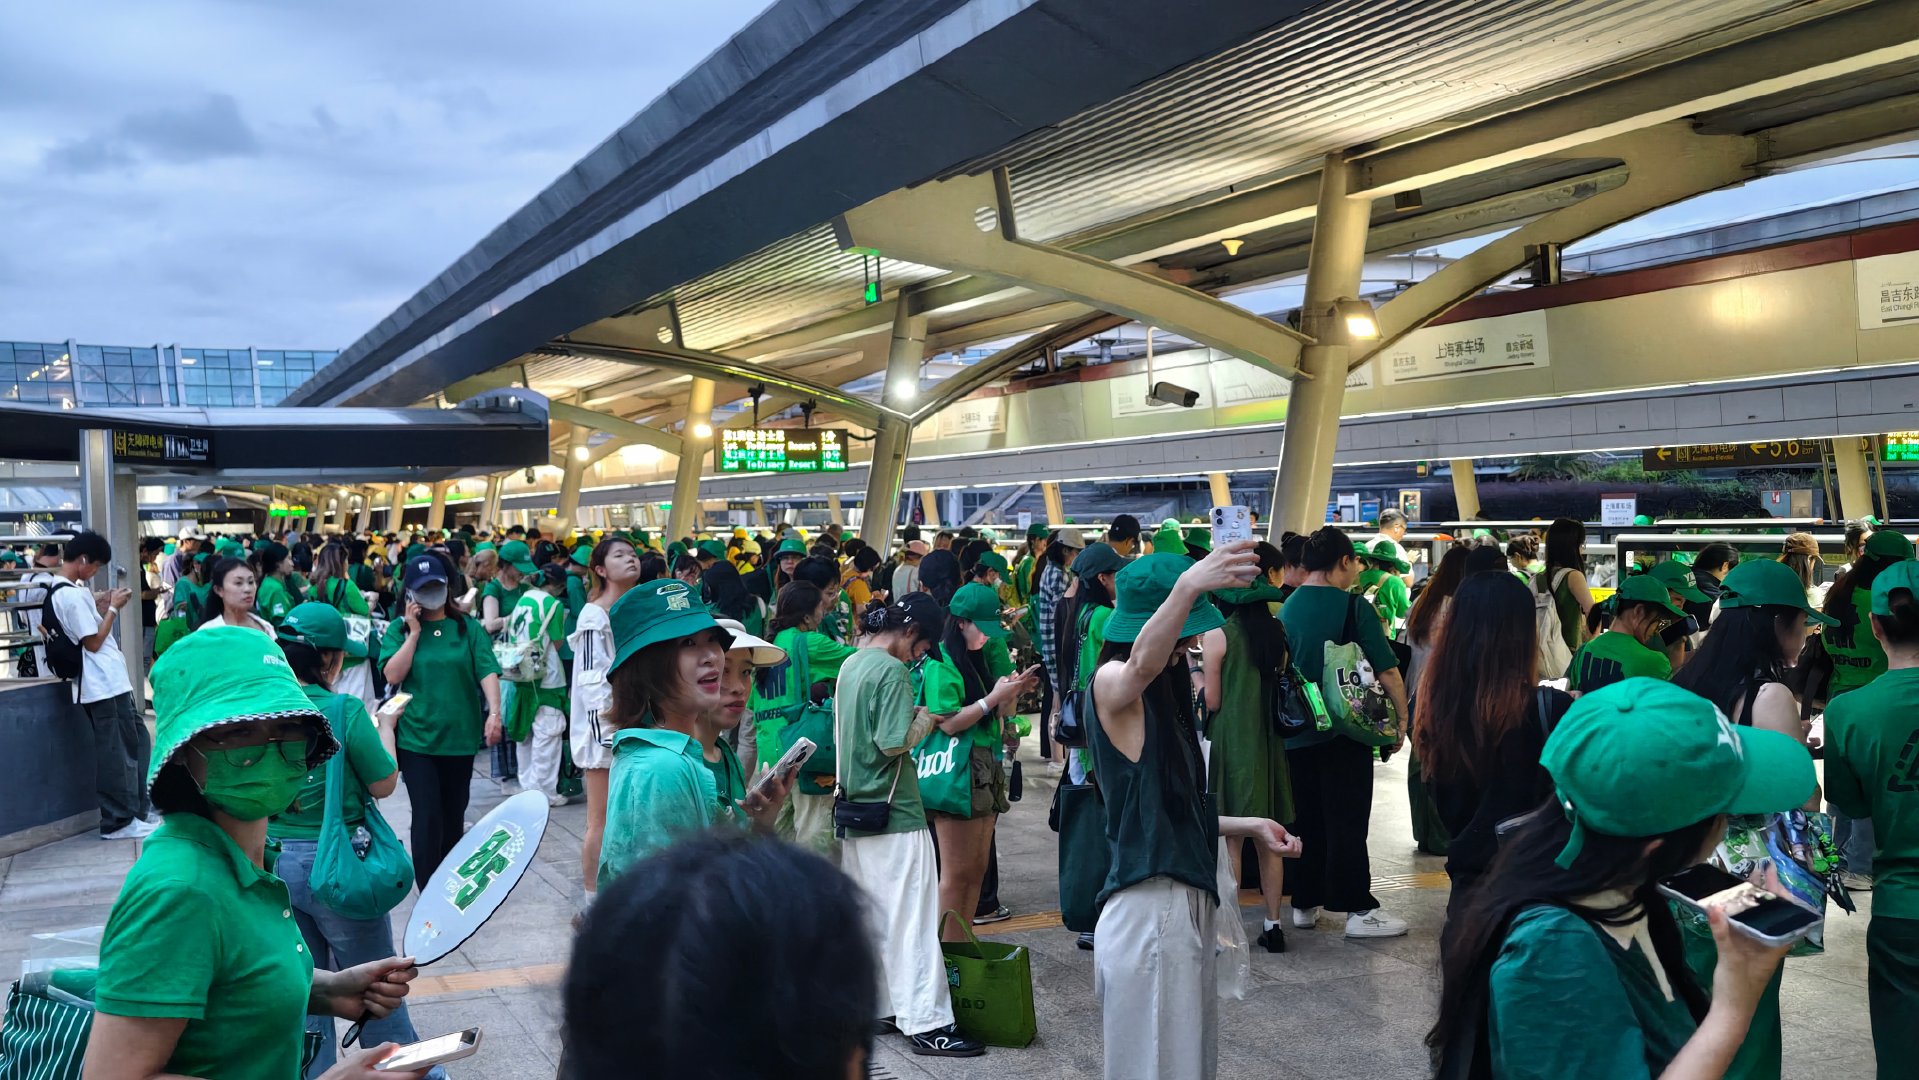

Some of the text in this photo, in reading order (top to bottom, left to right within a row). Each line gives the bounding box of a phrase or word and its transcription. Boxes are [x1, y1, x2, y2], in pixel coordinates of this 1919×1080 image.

[1435, 337, 1485, 359] 上海赛车场
[910, 737, 960, 779] trol
